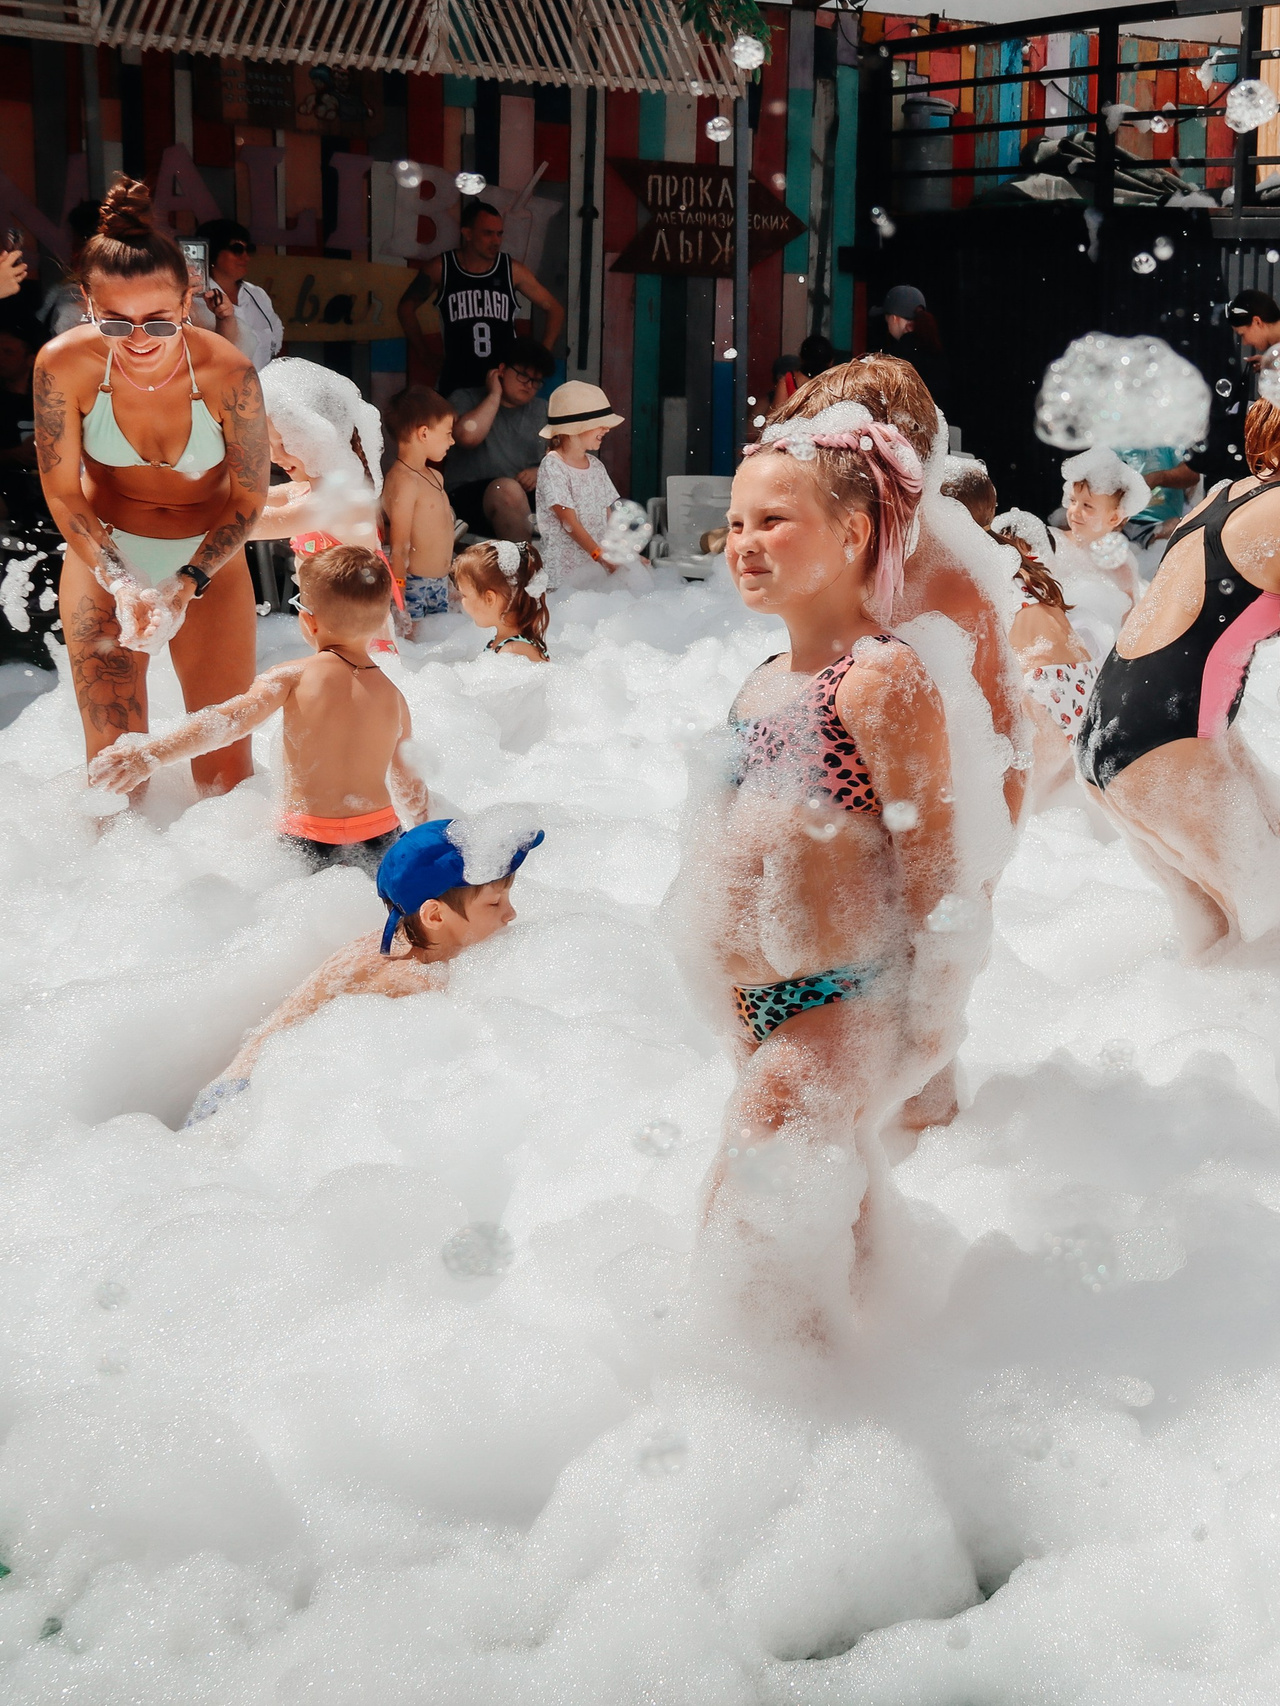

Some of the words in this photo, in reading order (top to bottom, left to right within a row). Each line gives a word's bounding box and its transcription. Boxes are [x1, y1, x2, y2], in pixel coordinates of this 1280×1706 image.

[647, 173, 756, 209] ПРОКА
[288, 273, 385, 325] bar
[448, 289, 509, 323] CHICAGO
[472, 322, 492, 358] 8
